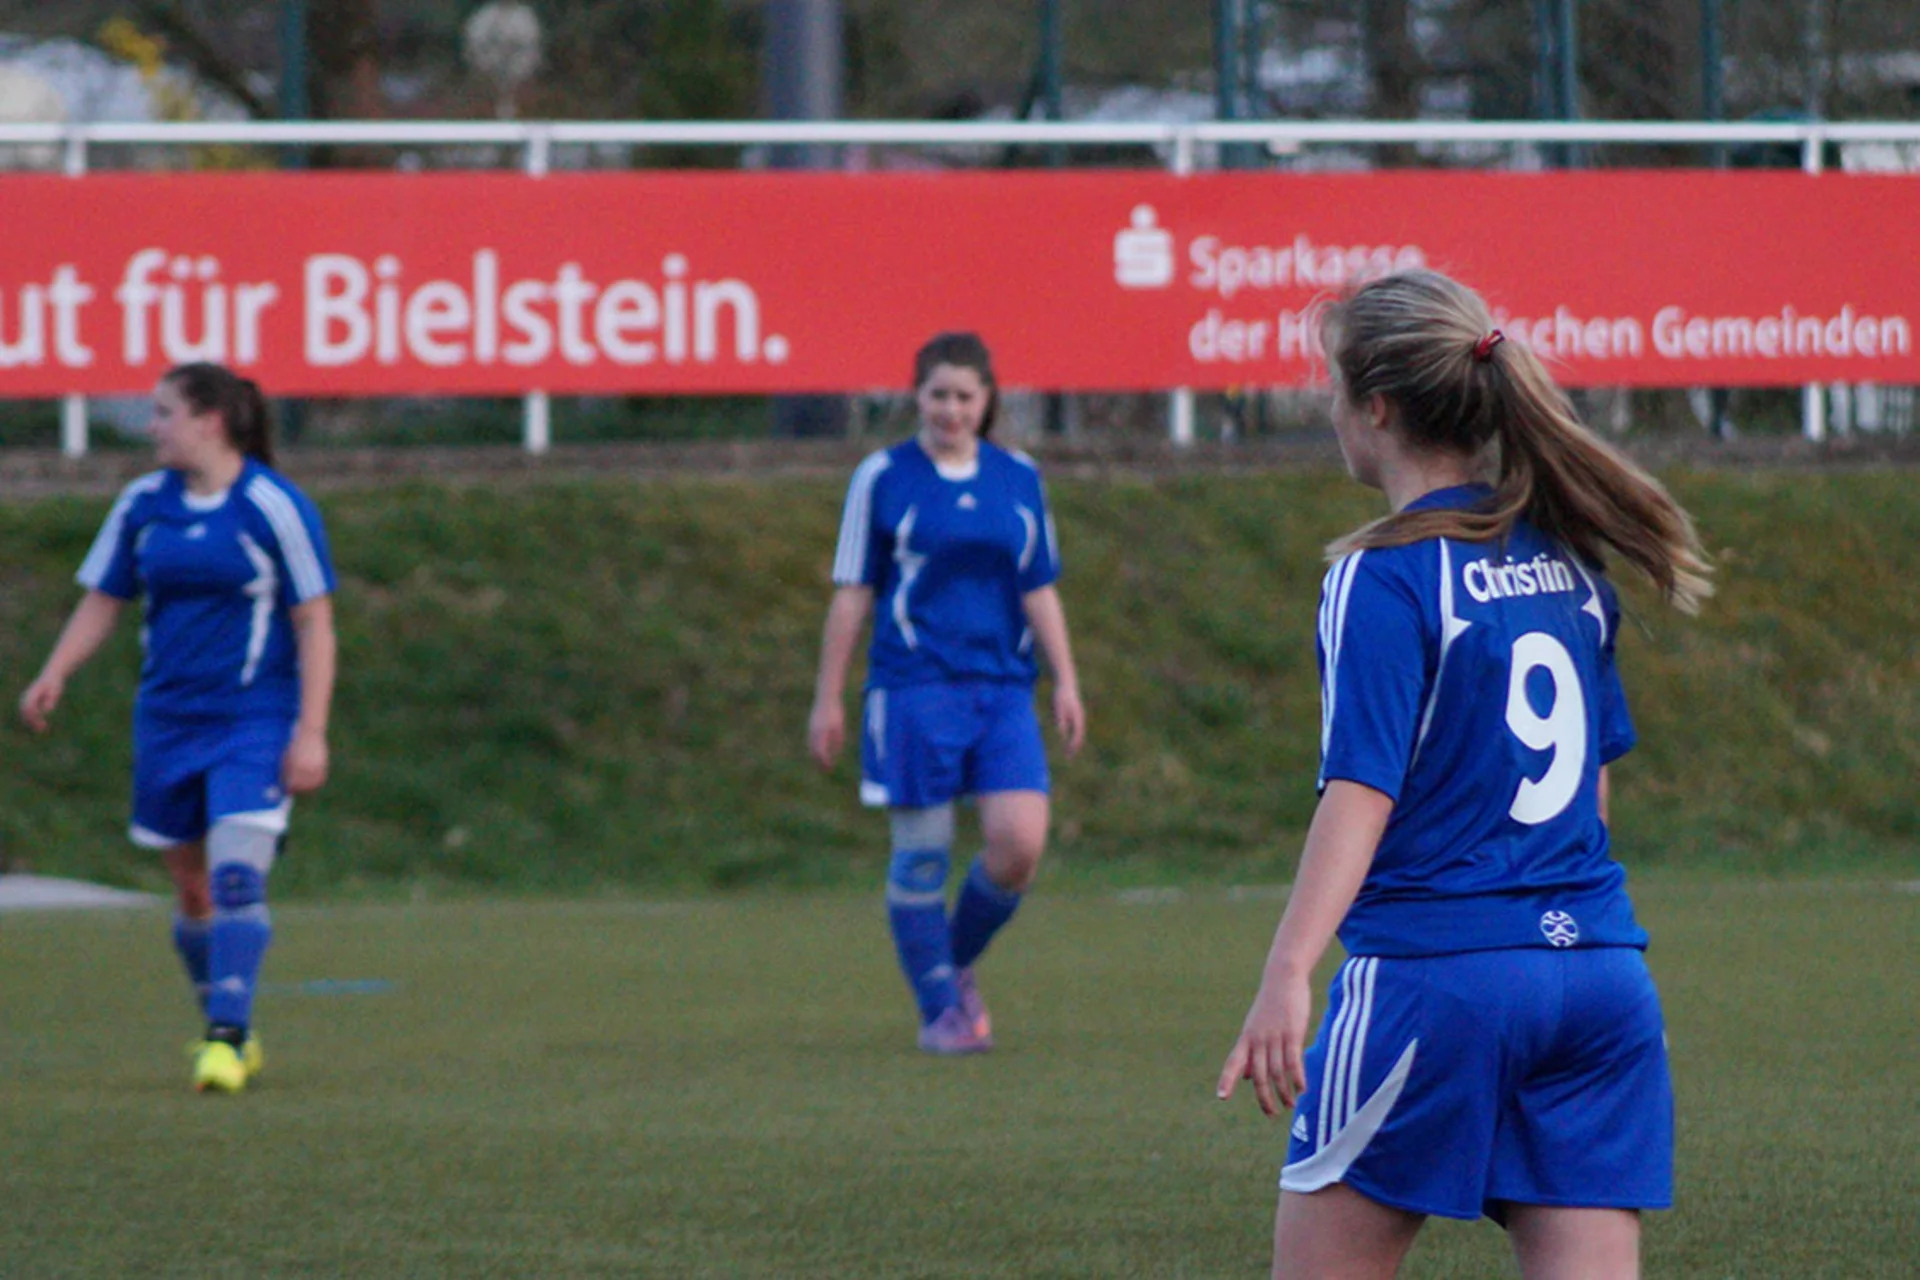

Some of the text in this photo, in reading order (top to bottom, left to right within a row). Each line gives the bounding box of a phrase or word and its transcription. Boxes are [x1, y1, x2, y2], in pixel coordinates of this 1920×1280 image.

[1189, 234, 1425, 297] Sparkasse
[114, 248, 278, 367] für
[303, 248, 789, 366] Bielstein.
[1188, 308, 1269, 361] der
[1651, 302, 1911, 359] Gemeinden
[1463, 552, 1575, 602] Christin
[1505, 631, 1587, 825] 9
